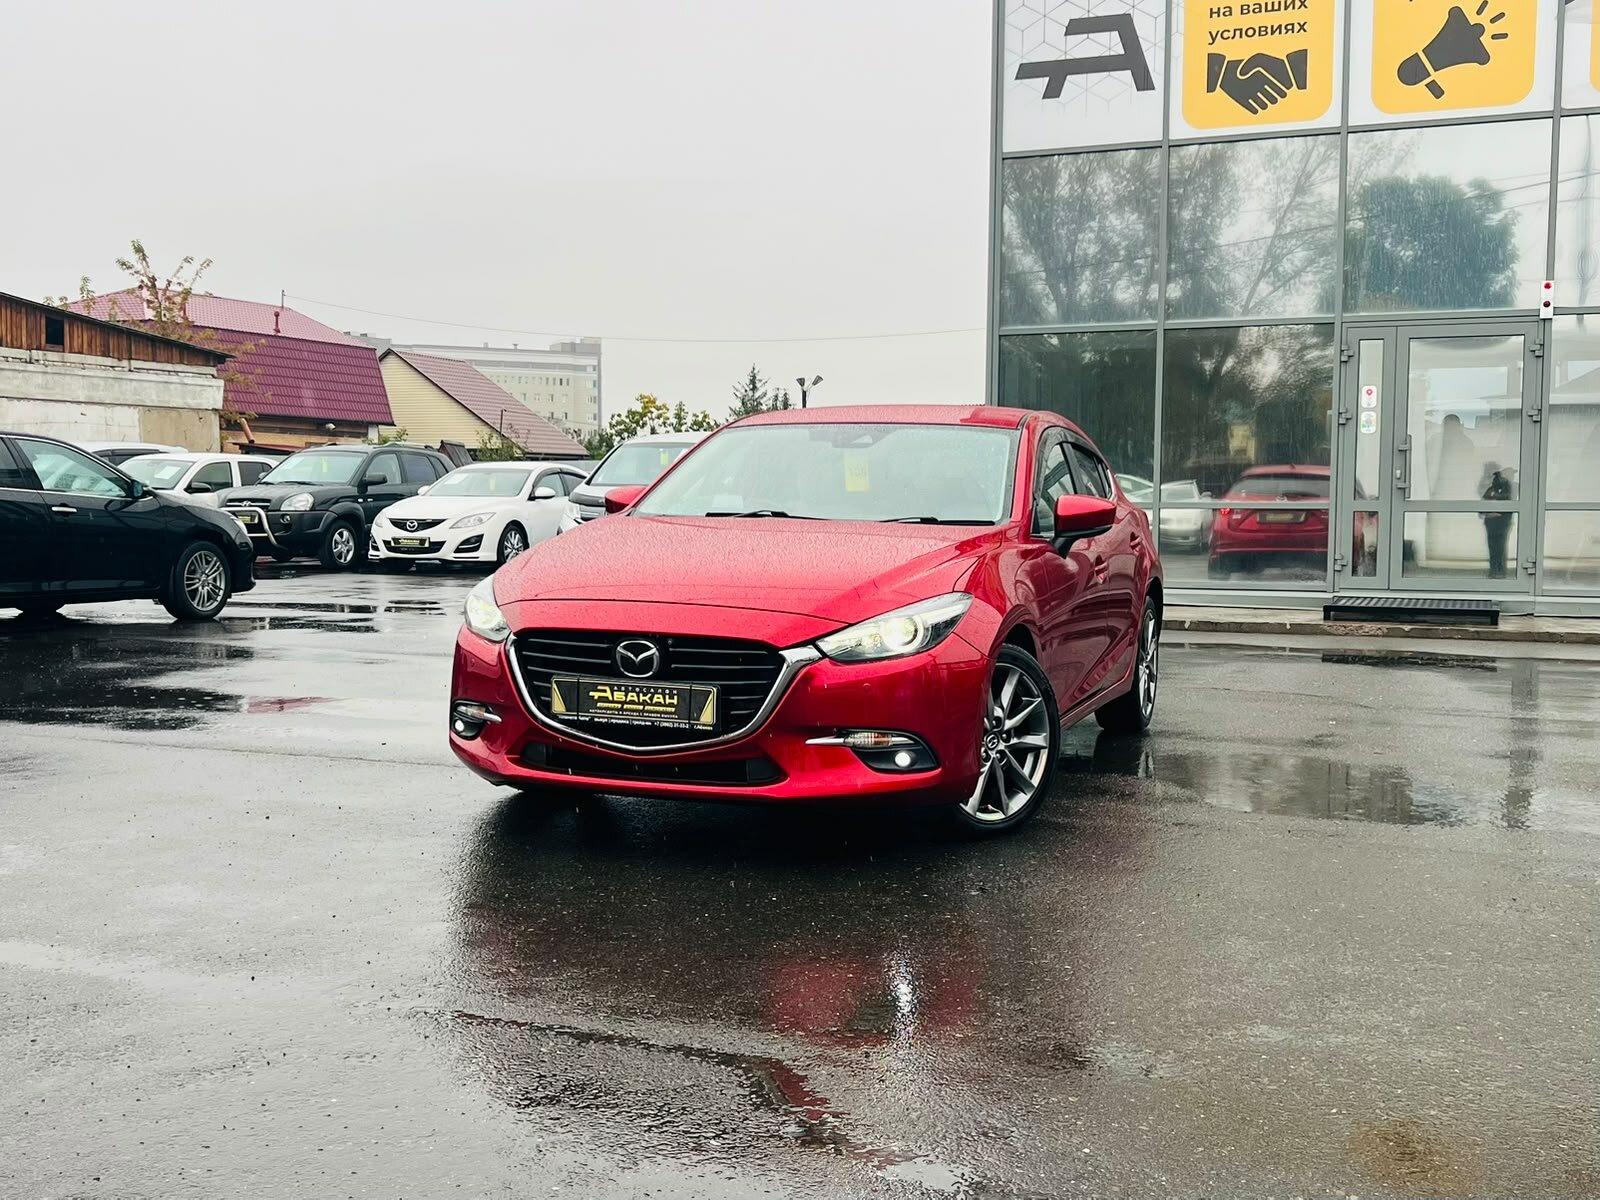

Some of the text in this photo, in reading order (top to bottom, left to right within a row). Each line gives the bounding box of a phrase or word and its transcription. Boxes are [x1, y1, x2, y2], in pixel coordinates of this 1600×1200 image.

[1209, 0, 1308, 18] на ваших
[1208, 21, 1308, 45] условиях
[613, 686, 677, 694] АВТОСАЛОН
